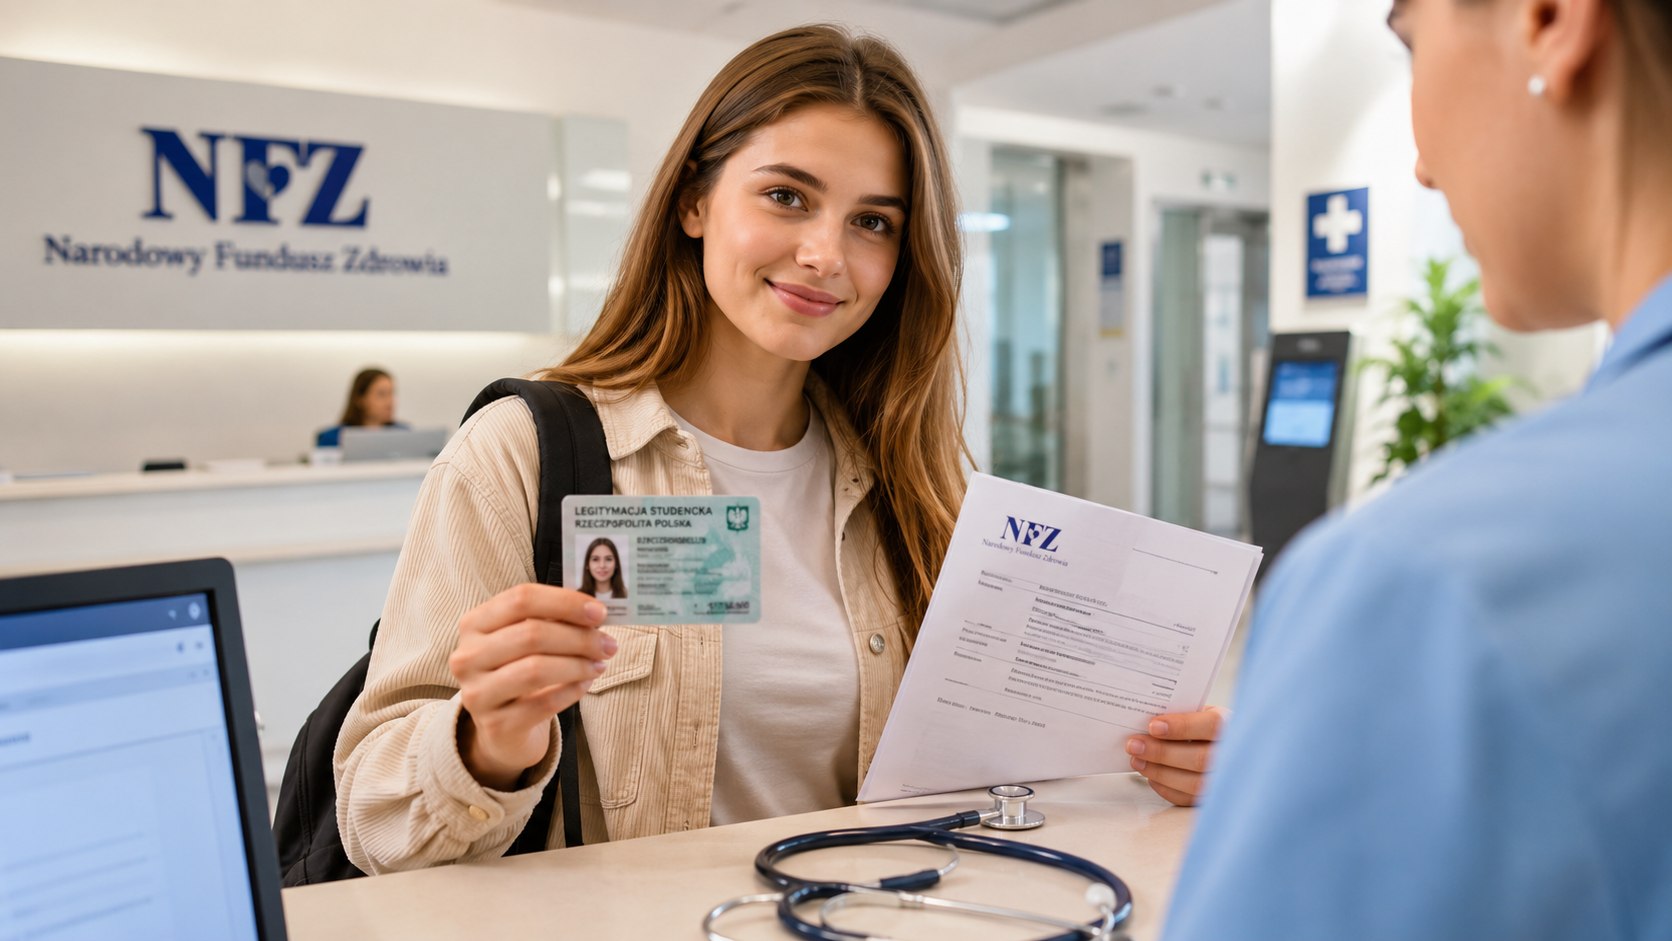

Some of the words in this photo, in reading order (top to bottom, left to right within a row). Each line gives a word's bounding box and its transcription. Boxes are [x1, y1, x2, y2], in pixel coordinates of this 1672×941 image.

[139, 126, 371, 228] NFZ
[42, 235, 207, 275] Narodowy
[214, 241, 337, 274] Fundusz
[342, 245, 450, 277] Zdrowia
[575, 506, 647, 515] LEGITYMACJA
[650, 506, 713, 516] STUDENCKA
[654, 519, 692, 528] POLSKA
[1000, 515, 1062, 552] NFZ
